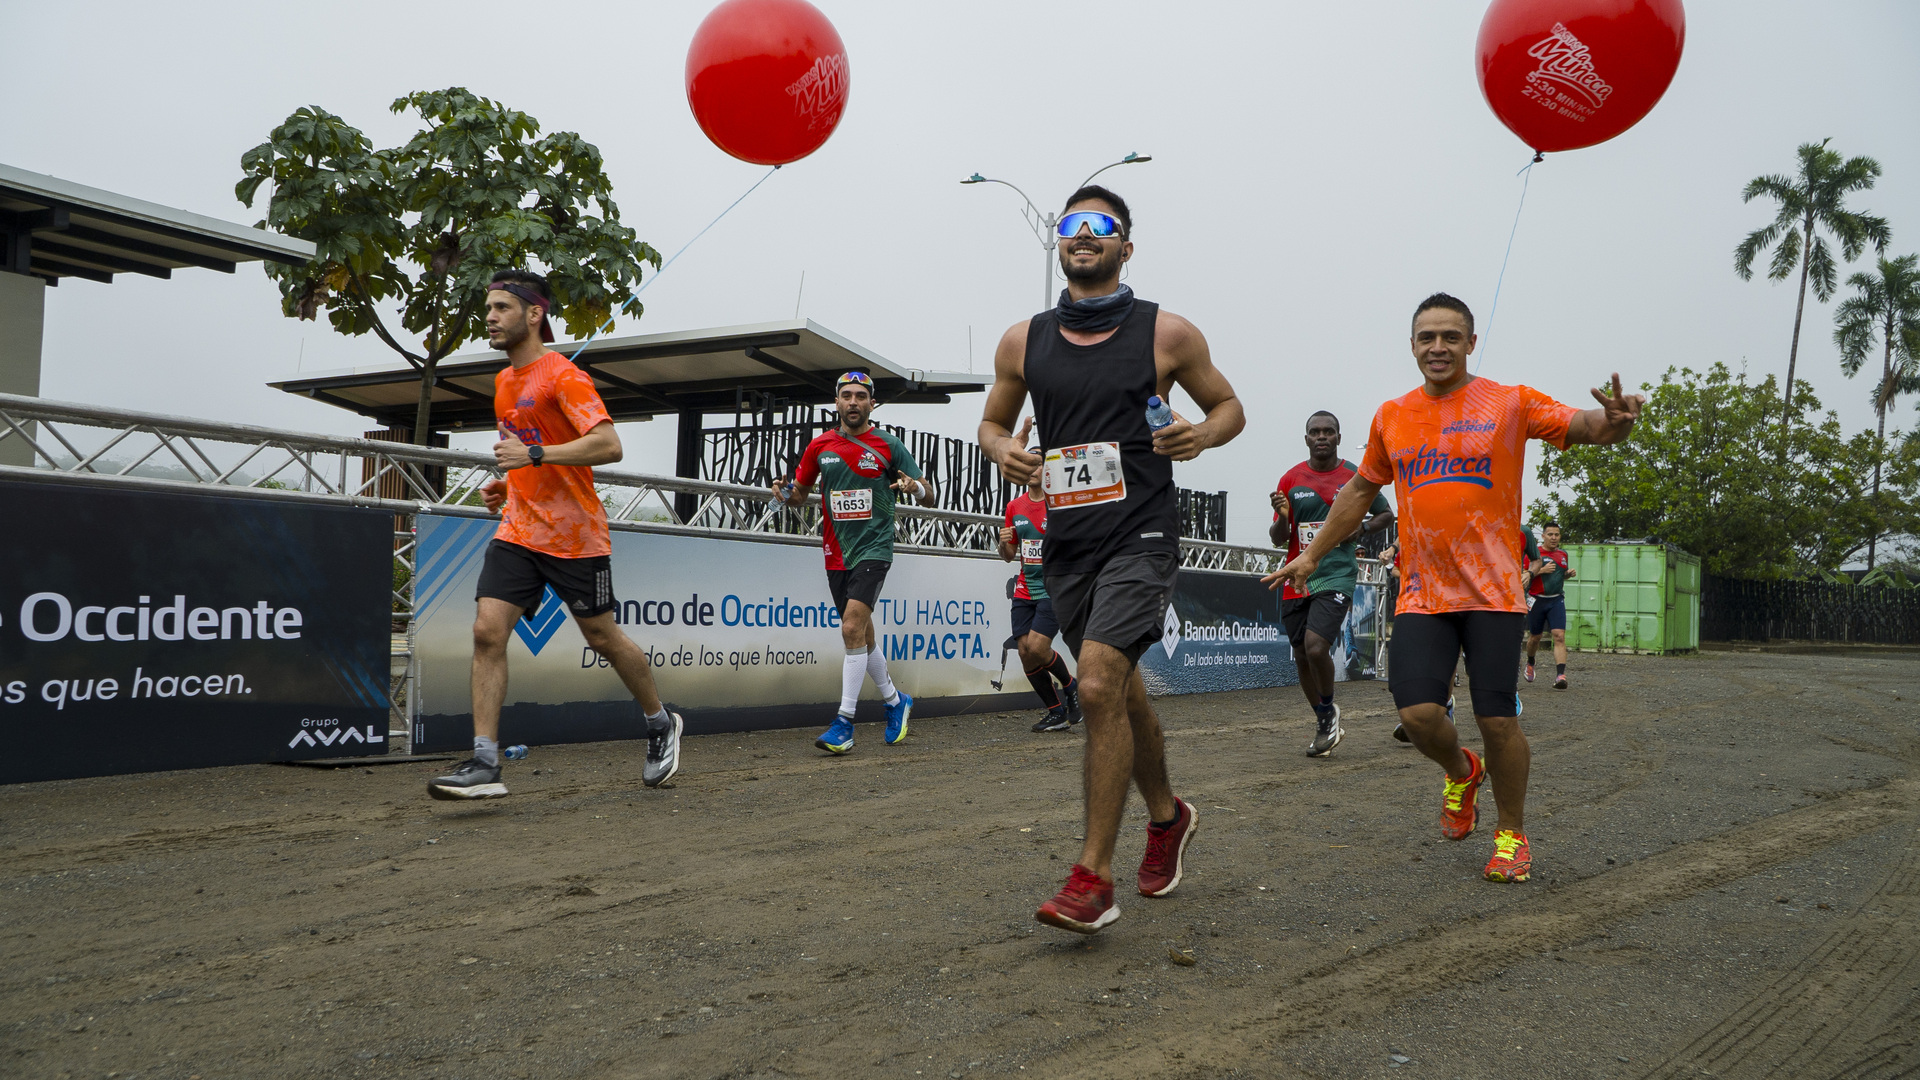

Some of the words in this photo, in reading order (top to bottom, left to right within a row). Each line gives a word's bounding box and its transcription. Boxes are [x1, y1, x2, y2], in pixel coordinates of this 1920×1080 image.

[1550, 22, 1582, 50] PASTAS
[1527, 35, 1613, 101] Muñeca
[1521, 85, 1558, 110] 27:30
[1557, 107, 1586, 122] MINS
[1526, 71, 1556, 96] 5:30
[1555, 92, 1596, 116] MIN/KM
[1442, 419, 1496, 435] ENERGÍA
[1391, 445, 1415, 460] PASTAS
[1417, 443, 1438, 459] La
[1064, 464, 1092, 487] 74
[1398, 453, 1491, 488] Muñeca
[837, 499, 865, 511] 1653
[20, 592, 302, 642] Occidente
[682, 593, 715, 626] de
[721, 594, 840, 628] Occidente
[879, 599, 907, 626] TU
[916, 600, 990, 629] HACER,
[1185, 620, 1217, 641] Banco
[1218, 621, 1231, 641] de
[1232, 621, 1278, 641] Occidente
[581, 646, 613, 668] De
[670, 645, 693, 666] de
[699, 645, 724, 666] los
[729, 651, 760, 671] que
[765, 645, 817, 665] hacen.
[883, 633, 990, 660] IMPACTA.
[1184, 652, 1197, 666] Del
[1197, 651, 1213, 666] lado
[1214, 651, 1223, 665] de
[1224, 651, 1234, 665] los
[1235, 655, 1248, 667] que
[1248, 651, 1269, 664] hacen.
[0, 680, 27, 704] s
[41, 678, 119, 710] que
[131, 667, 252, 698] hacen.
[301, 718, 339, 728] Grupo
[288, 725, 383, 749] AVAL
